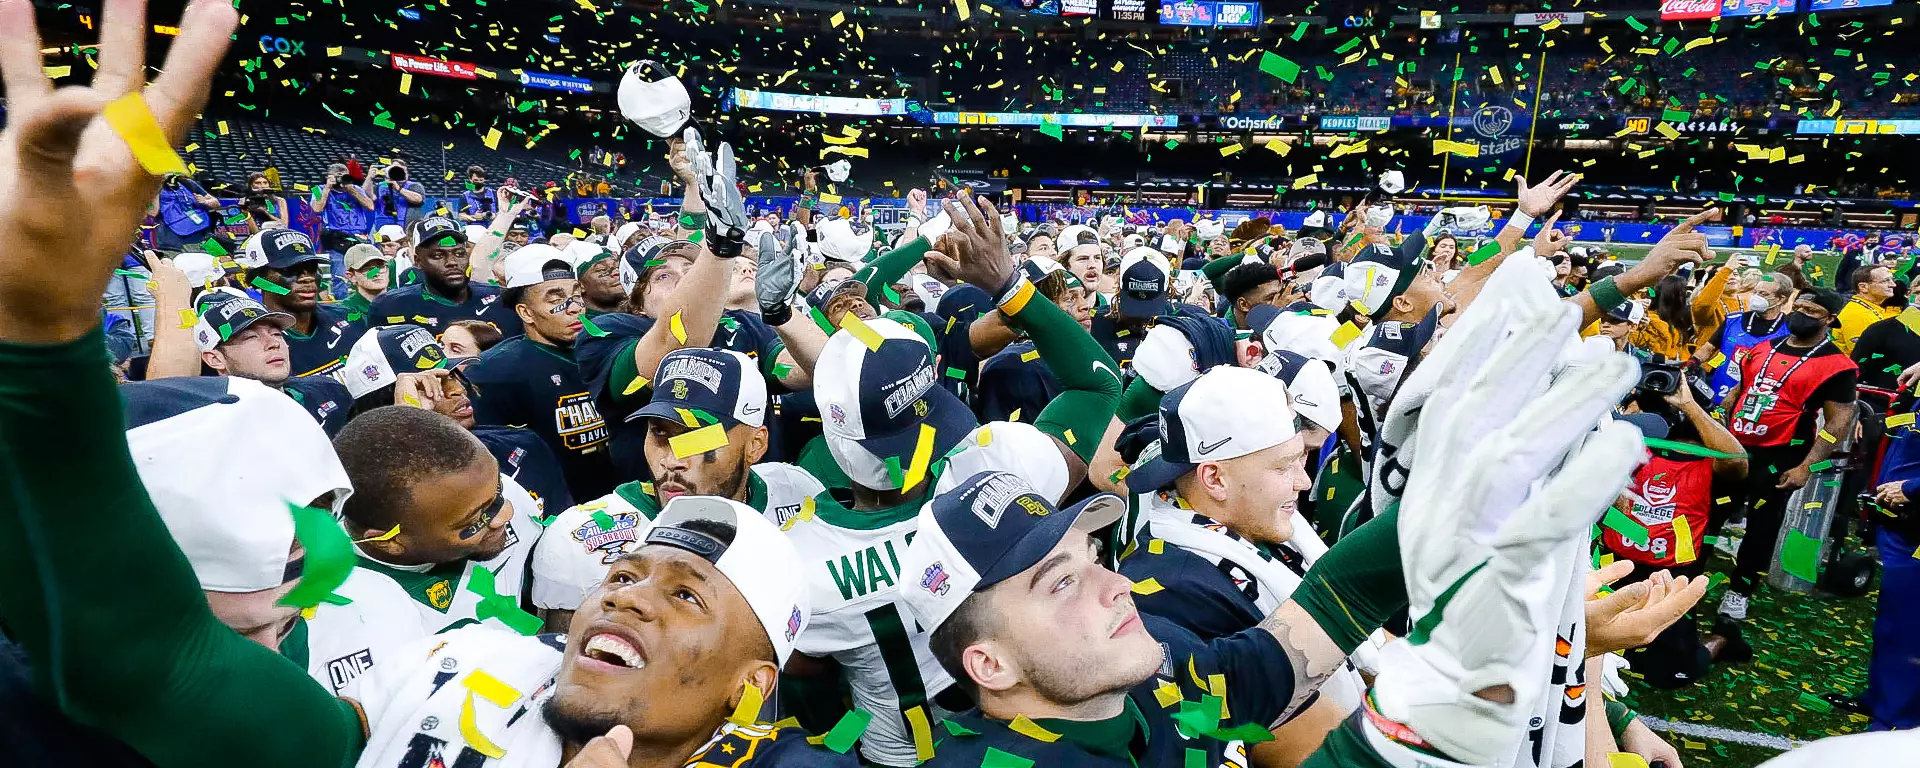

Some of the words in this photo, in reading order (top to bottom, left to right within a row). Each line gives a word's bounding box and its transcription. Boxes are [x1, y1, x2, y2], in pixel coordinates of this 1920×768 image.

[1113, 11, 1132, 20] 11:35
[1133, 12, 1145, 20] PM
[1222, 4, 1247, 14] BUD
[79, 14, 93, 30] 4
[1344, 16, 1374, 27] COX
[260, 35, 306, 56] COX
[408, 57, 433, 71] Power
[530, 76, 561, 86] HANCOCK
[1226, 116, 1284, 129] Ochsner
[1322, 118, 1356, 129] PEOPLES
[1358, 119, 1389, 129] HEALTH
[1626, 119, 1648, 133] 40
[659, 359, 723, 395] CHAMPS
[884, 364, 936, 419] CHAMP
[580, 428, 609, 444] BAYL
[777, 505, 800, 524] ONE
[1634, 503, 1673, 518] COLLEGE
[585, 520, 630, 538] Allate
[329, 650, 373, 690] ONE
